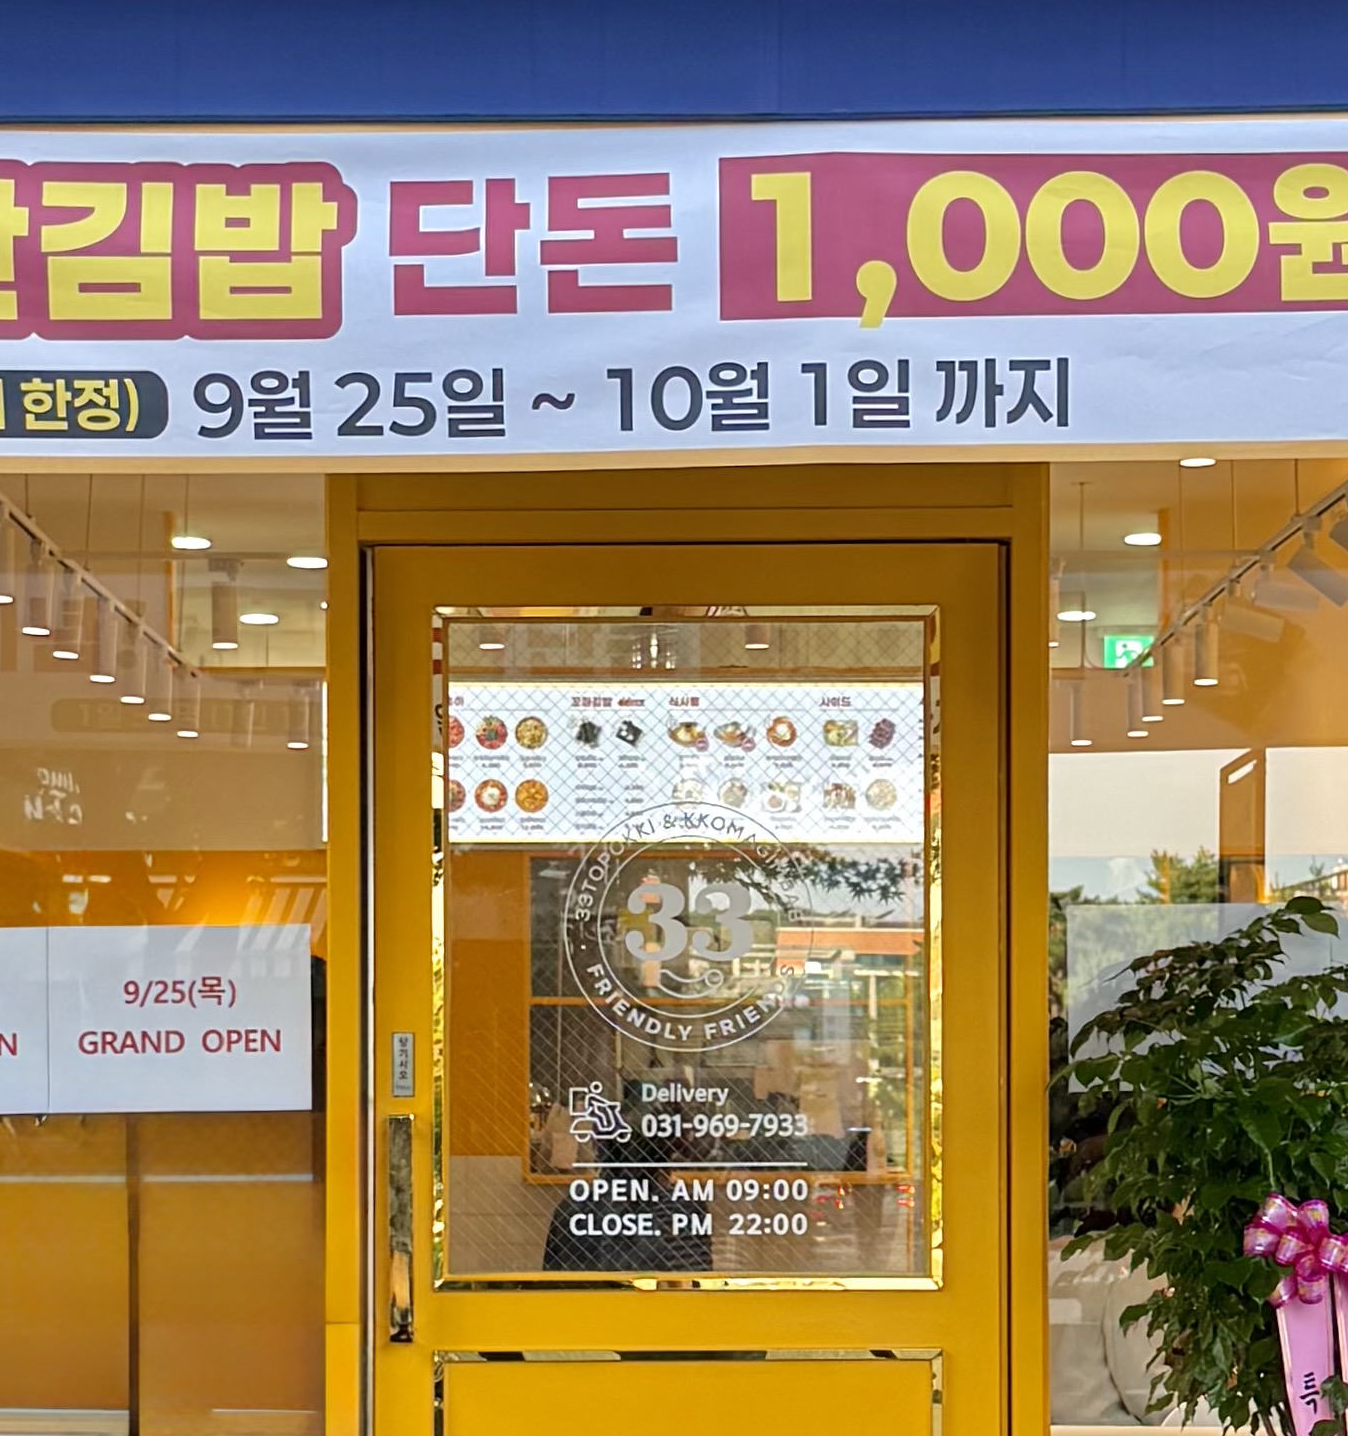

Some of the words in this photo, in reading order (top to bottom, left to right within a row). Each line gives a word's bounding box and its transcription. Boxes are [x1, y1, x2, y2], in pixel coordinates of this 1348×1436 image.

[389, 173, 679, 317] 단돈
[20, 376, 141, 433] 한정)
[192, 370, 316, 441] 9월
[336, 367, 506, 438] 25일
[605, 362, 770, 432] 10월
[799, 359, 914, 430] 1일
[935, 356, 1072, 429] 까지
[624, 882, 753, 962] 33
[122, 975, 237, 1009] 9/25(목)
[77, 1029, 185, 1055] GRAND
[200, 1028, 282, 1053] OPEN
[641, 1082, 730, 1106] Delivery
[641, 1113, 809, 1138] 031-969-7933
[569, 1178, 660, 1202] OPEN.
[671, 1179, 715, 1202] AM
[726, 1179, 809, 1201] 09:00
[569, 1213, 662, 1237] CLOSE.
[672, 1213, 714, 1236] PM
[728, 1213, 809, 1236] 22:00
